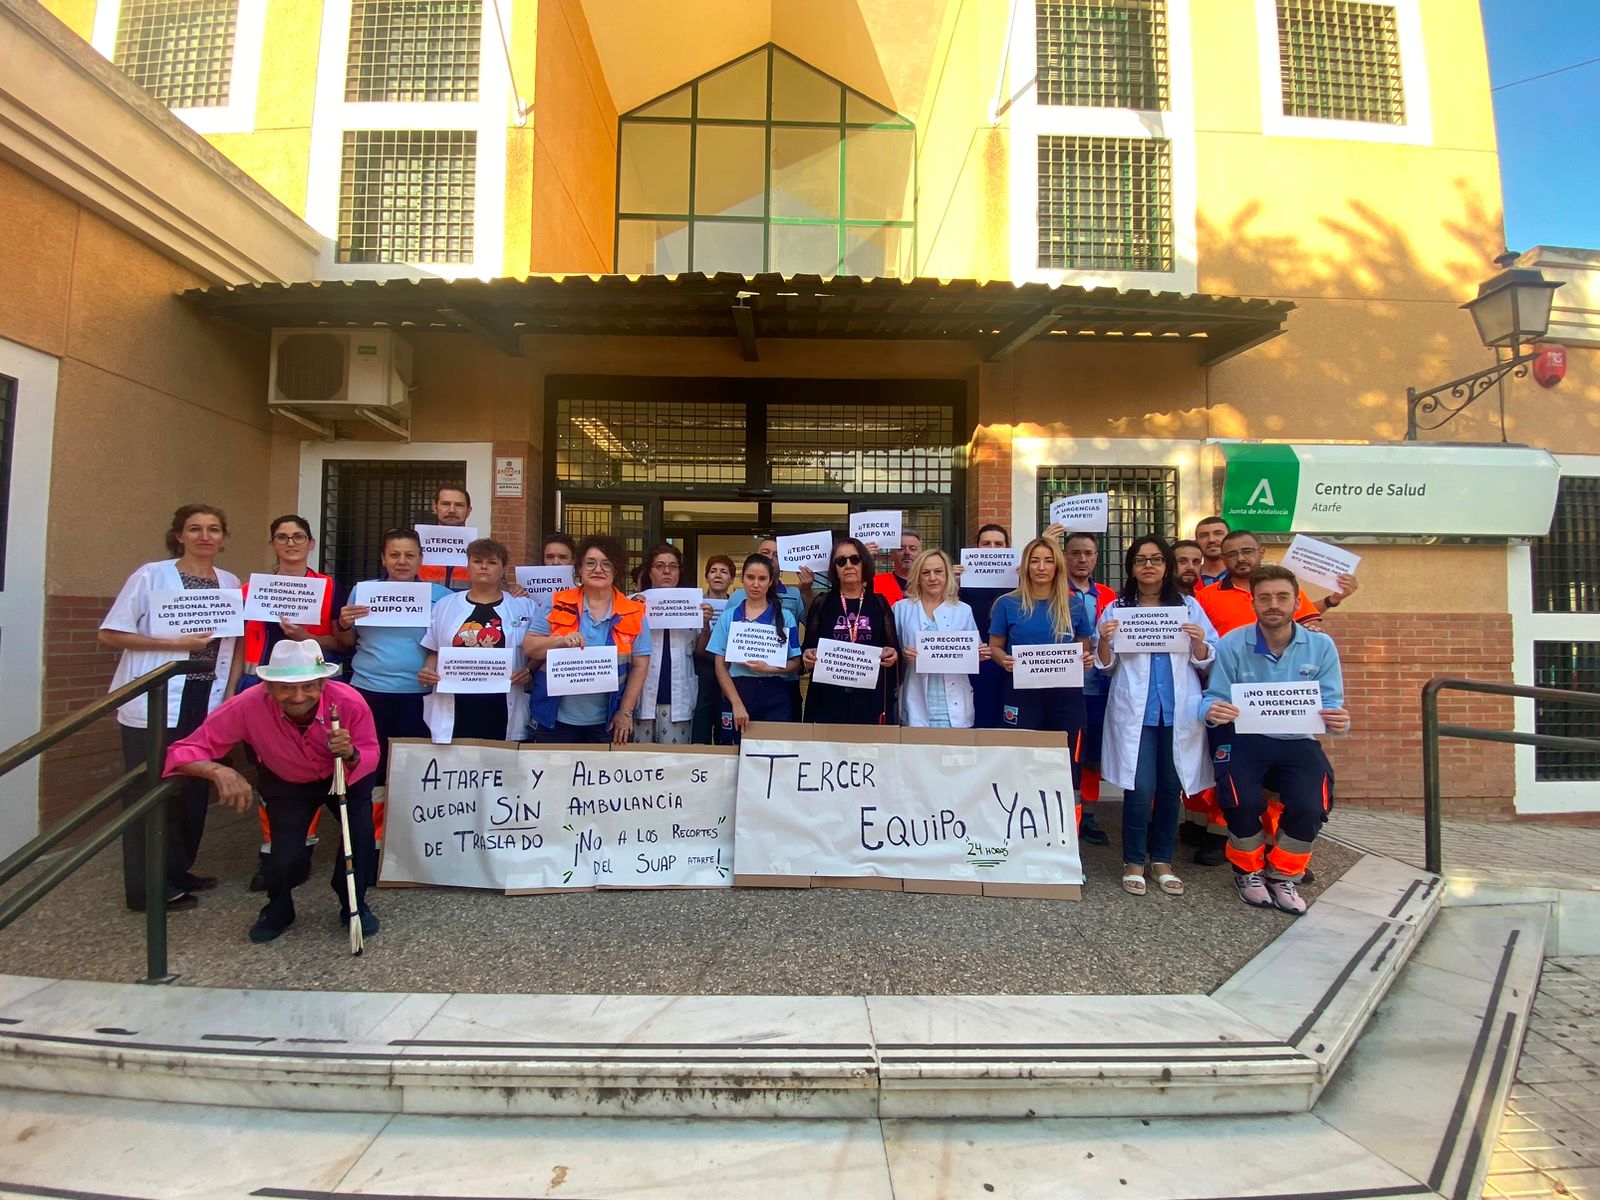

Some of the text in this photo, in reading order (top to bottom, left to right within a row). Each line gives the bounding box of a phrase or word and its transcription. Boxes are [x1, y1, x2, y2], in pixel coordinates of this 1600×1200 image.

[1315, 482, 1426, 496] Centro de Salud
[1312, 503, 1341, 512] Atarfe
[825, 652, 854, 661] PERSONAL
[421, 758, 708, 792] ATARFE Y ALBOLOTE SE
[745, 753, 876, 799] TERCER
[412, 801, 476, 824] QUEDAN
[992, 782, 1067, 847] YA!!
[424, 830, 544, 857] DE TRASLADO
[618, 829, 627, 846] A
[636, 828, 658, 843] LOS
[672, 824, 719, 840] RECORTES
[594, 859, 613, 874] DEL
[635, 855, 676, 874] SUAP
